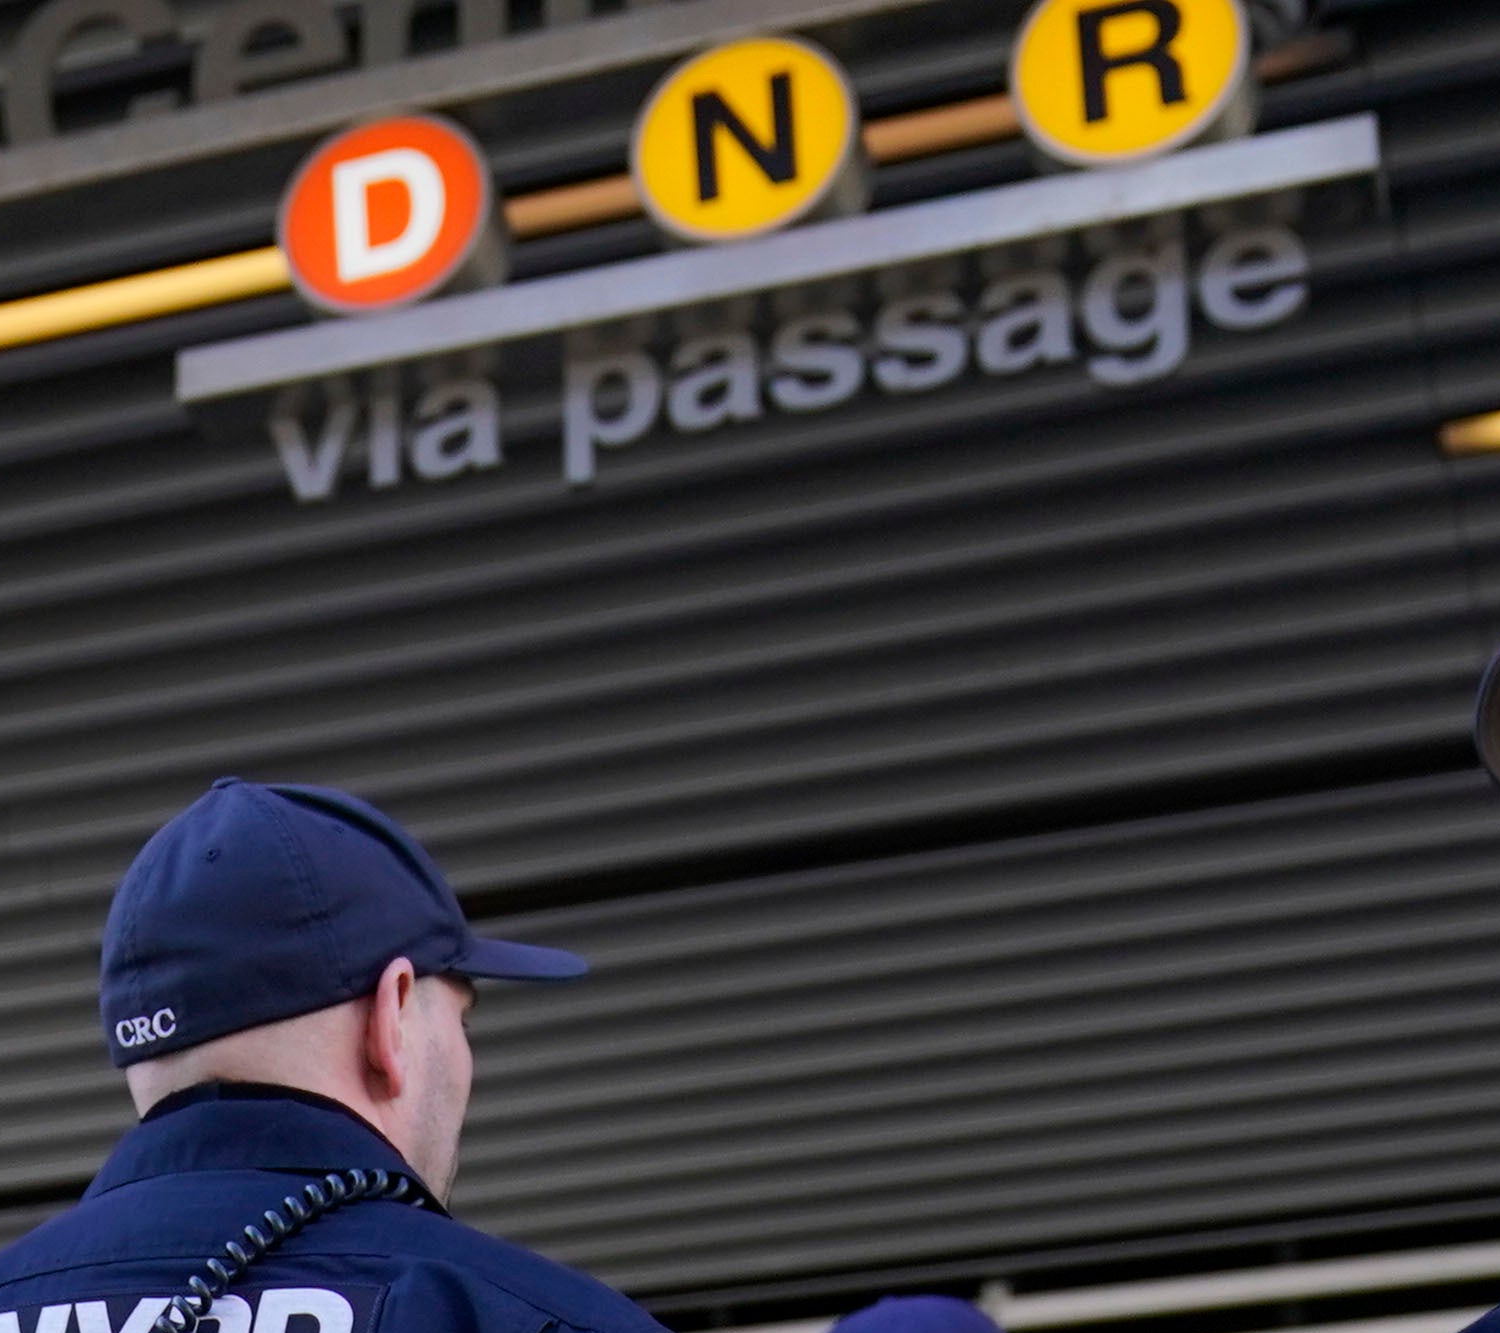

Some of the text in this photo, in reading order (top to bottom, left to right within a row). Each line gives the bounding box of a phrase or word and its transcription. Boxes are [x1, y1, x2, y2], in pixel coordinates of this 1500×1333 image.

[331, 0, 1188, 283] D N R
[270, 223, 1310, 503] via passage
[115, 1007, 177, 1048] CRC
